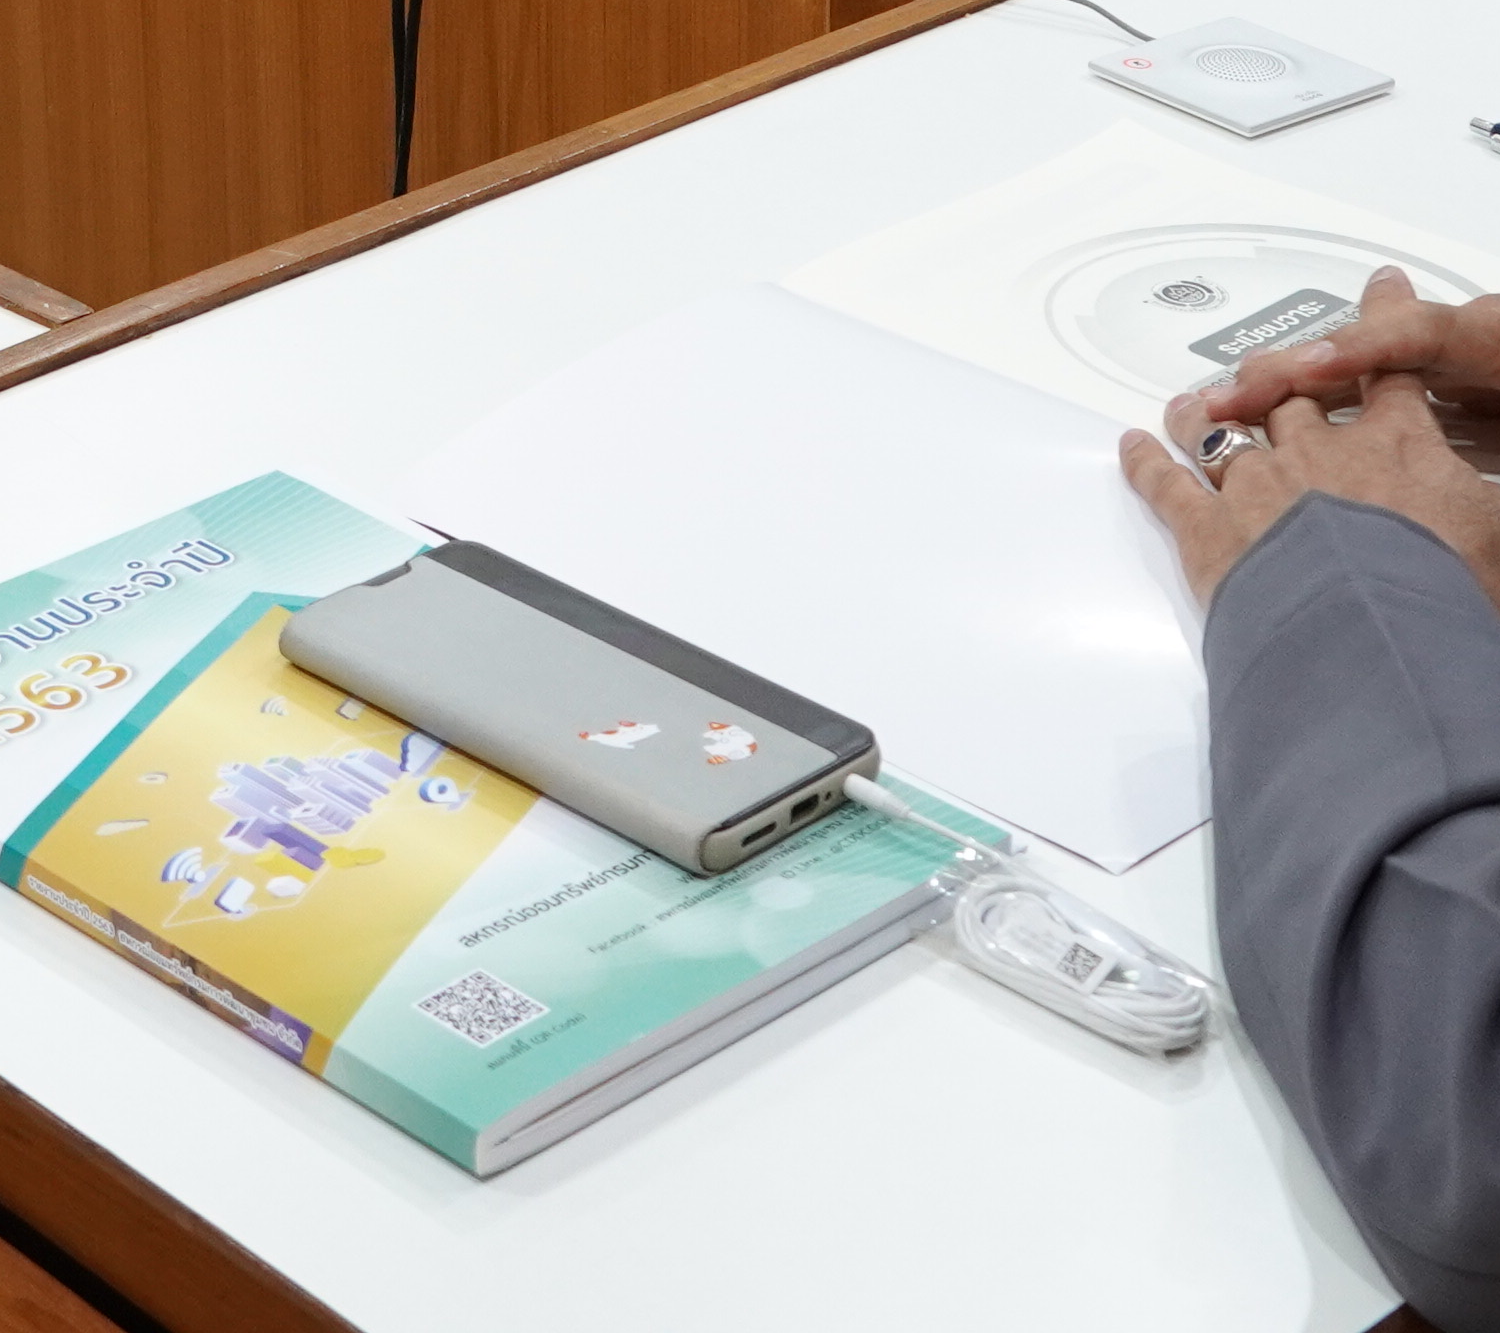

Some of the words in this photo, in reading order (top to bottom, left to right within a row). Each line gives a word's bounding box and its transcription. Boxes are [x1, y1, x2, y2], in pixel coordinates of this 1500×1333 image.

[1217, 300, 1327, 356] ระเบียบวาระ
[459, 847, 653, 948] สหกรณ์ออมทรัพย์กรมก
[586, 923, 646, 954] Facebook
